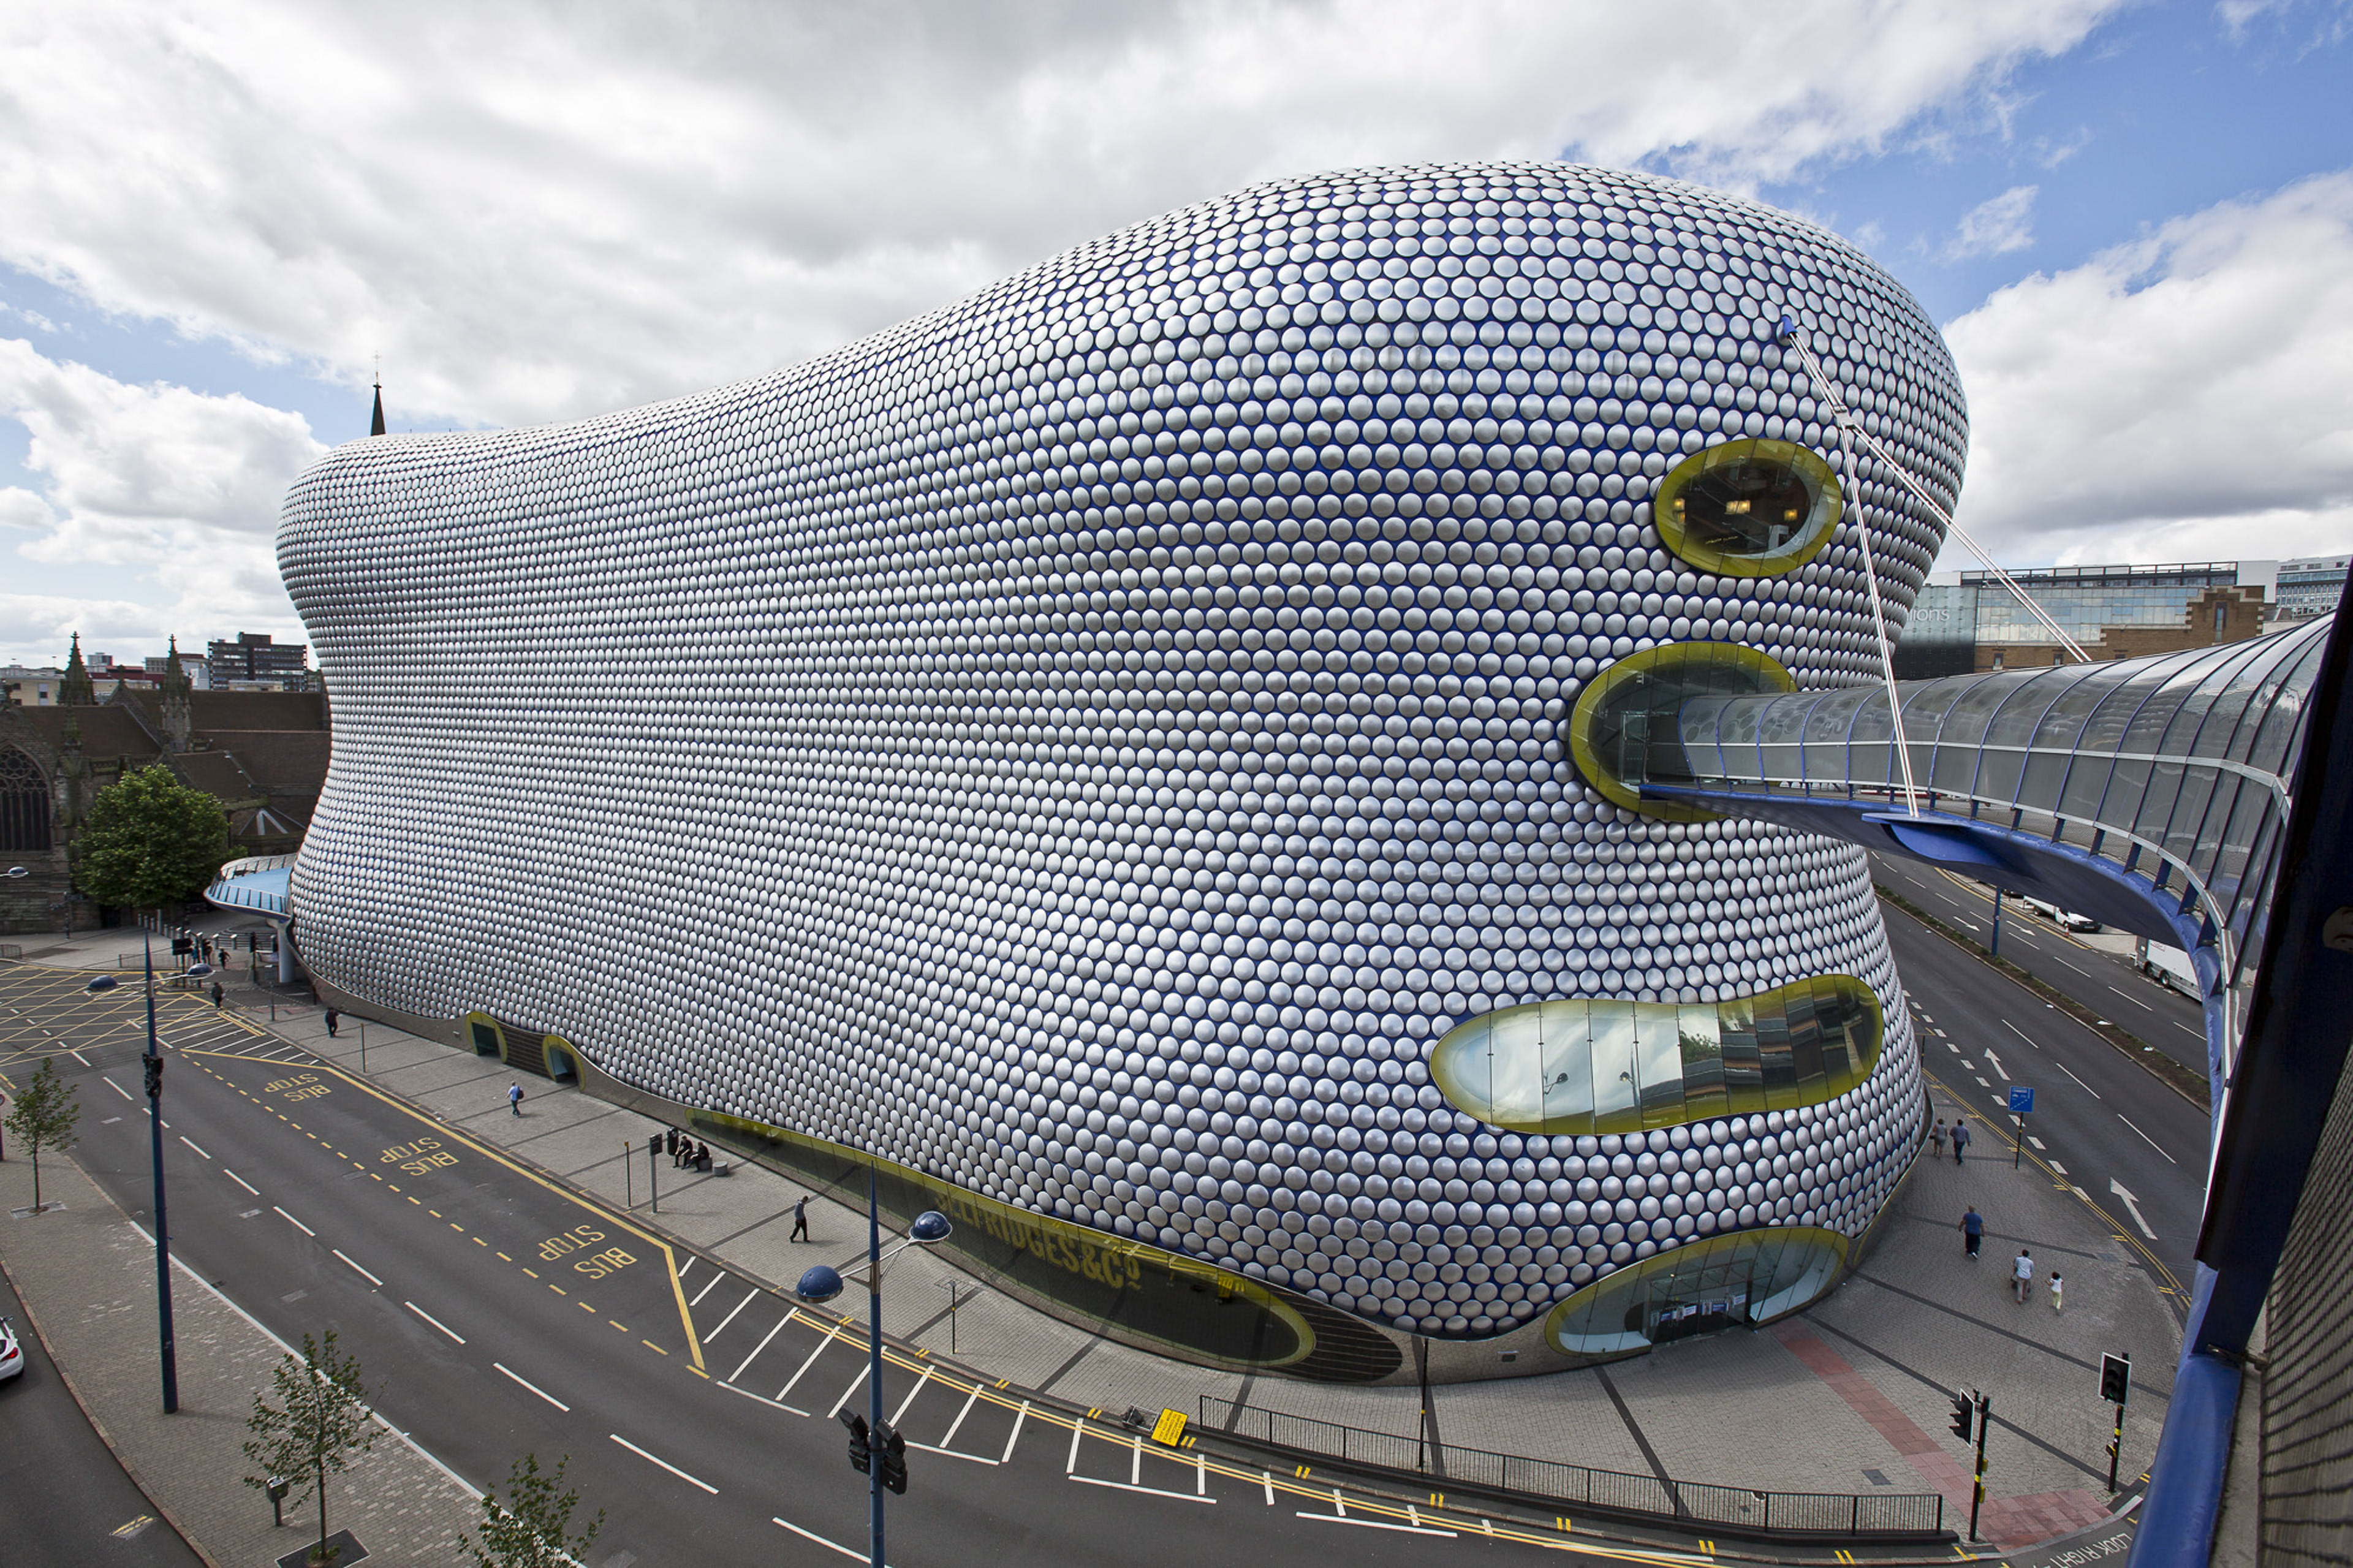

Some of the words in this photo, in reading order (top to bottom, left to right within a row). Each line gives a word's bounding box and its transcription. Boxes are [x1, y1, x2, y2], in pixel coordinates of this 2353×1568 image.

[264, 1074, 319, 1092] STOP
[284, 1085, 332, 1101] BUS
[380, 1137, 441, 1163] STOP
[400, 1152, 459, 1176] BUS
[538, 1225, 605, 1261] STOP
[574, 1247, 637, 1279] BUS
[2093, 1532, 2132, 1556] LOOK
[2050, 1546, 2102, 1568] RIGHT
